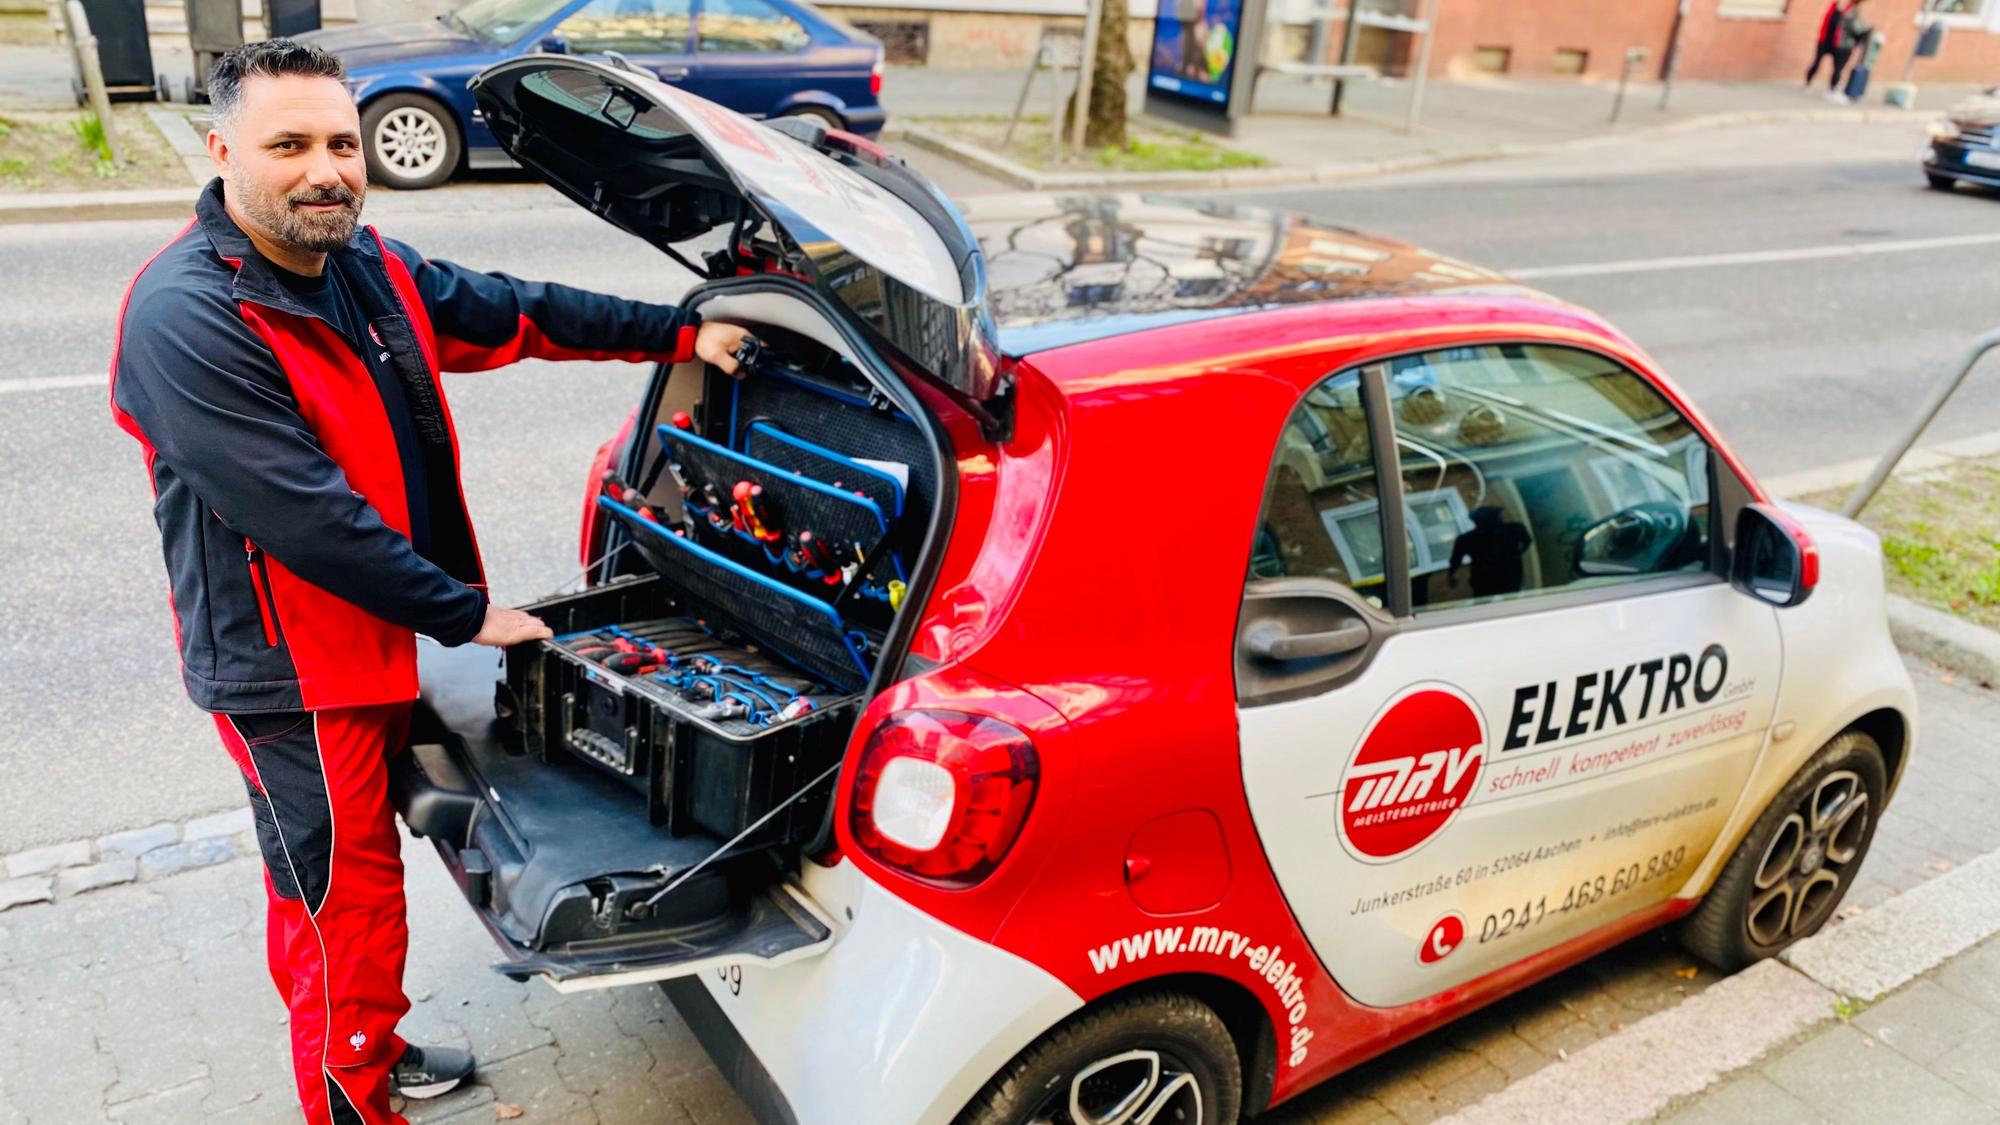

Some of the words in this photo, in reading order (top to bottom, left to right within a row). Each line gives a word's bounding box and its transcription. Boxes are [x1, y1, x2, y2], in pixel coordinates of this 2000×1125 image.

[1502, 643, 1728, 751] ELEKTRO
[1723, 677, 1757, 699] GmbH
[1489, 756, 1561, 793] schnell
[1569, 736, 1660, 775] kompetent
[1667, 710, 1747, 748] zuverlässig
[1353, 797, 1457, 828] MEISTERBETRIEB
[1350, 875, 1452, 915] Junkerstraße
[1455, 869, 1471, 886] 60
[1475, 864, 1489, 880] in
[1491, 851, 1531, 875] 52064
[1532, 836, 1582, 863] Aachen
[1479, 876, 1606, 944] 0241-468
[1088, 926, 1314, 1067] www.mrv-elektro.de
